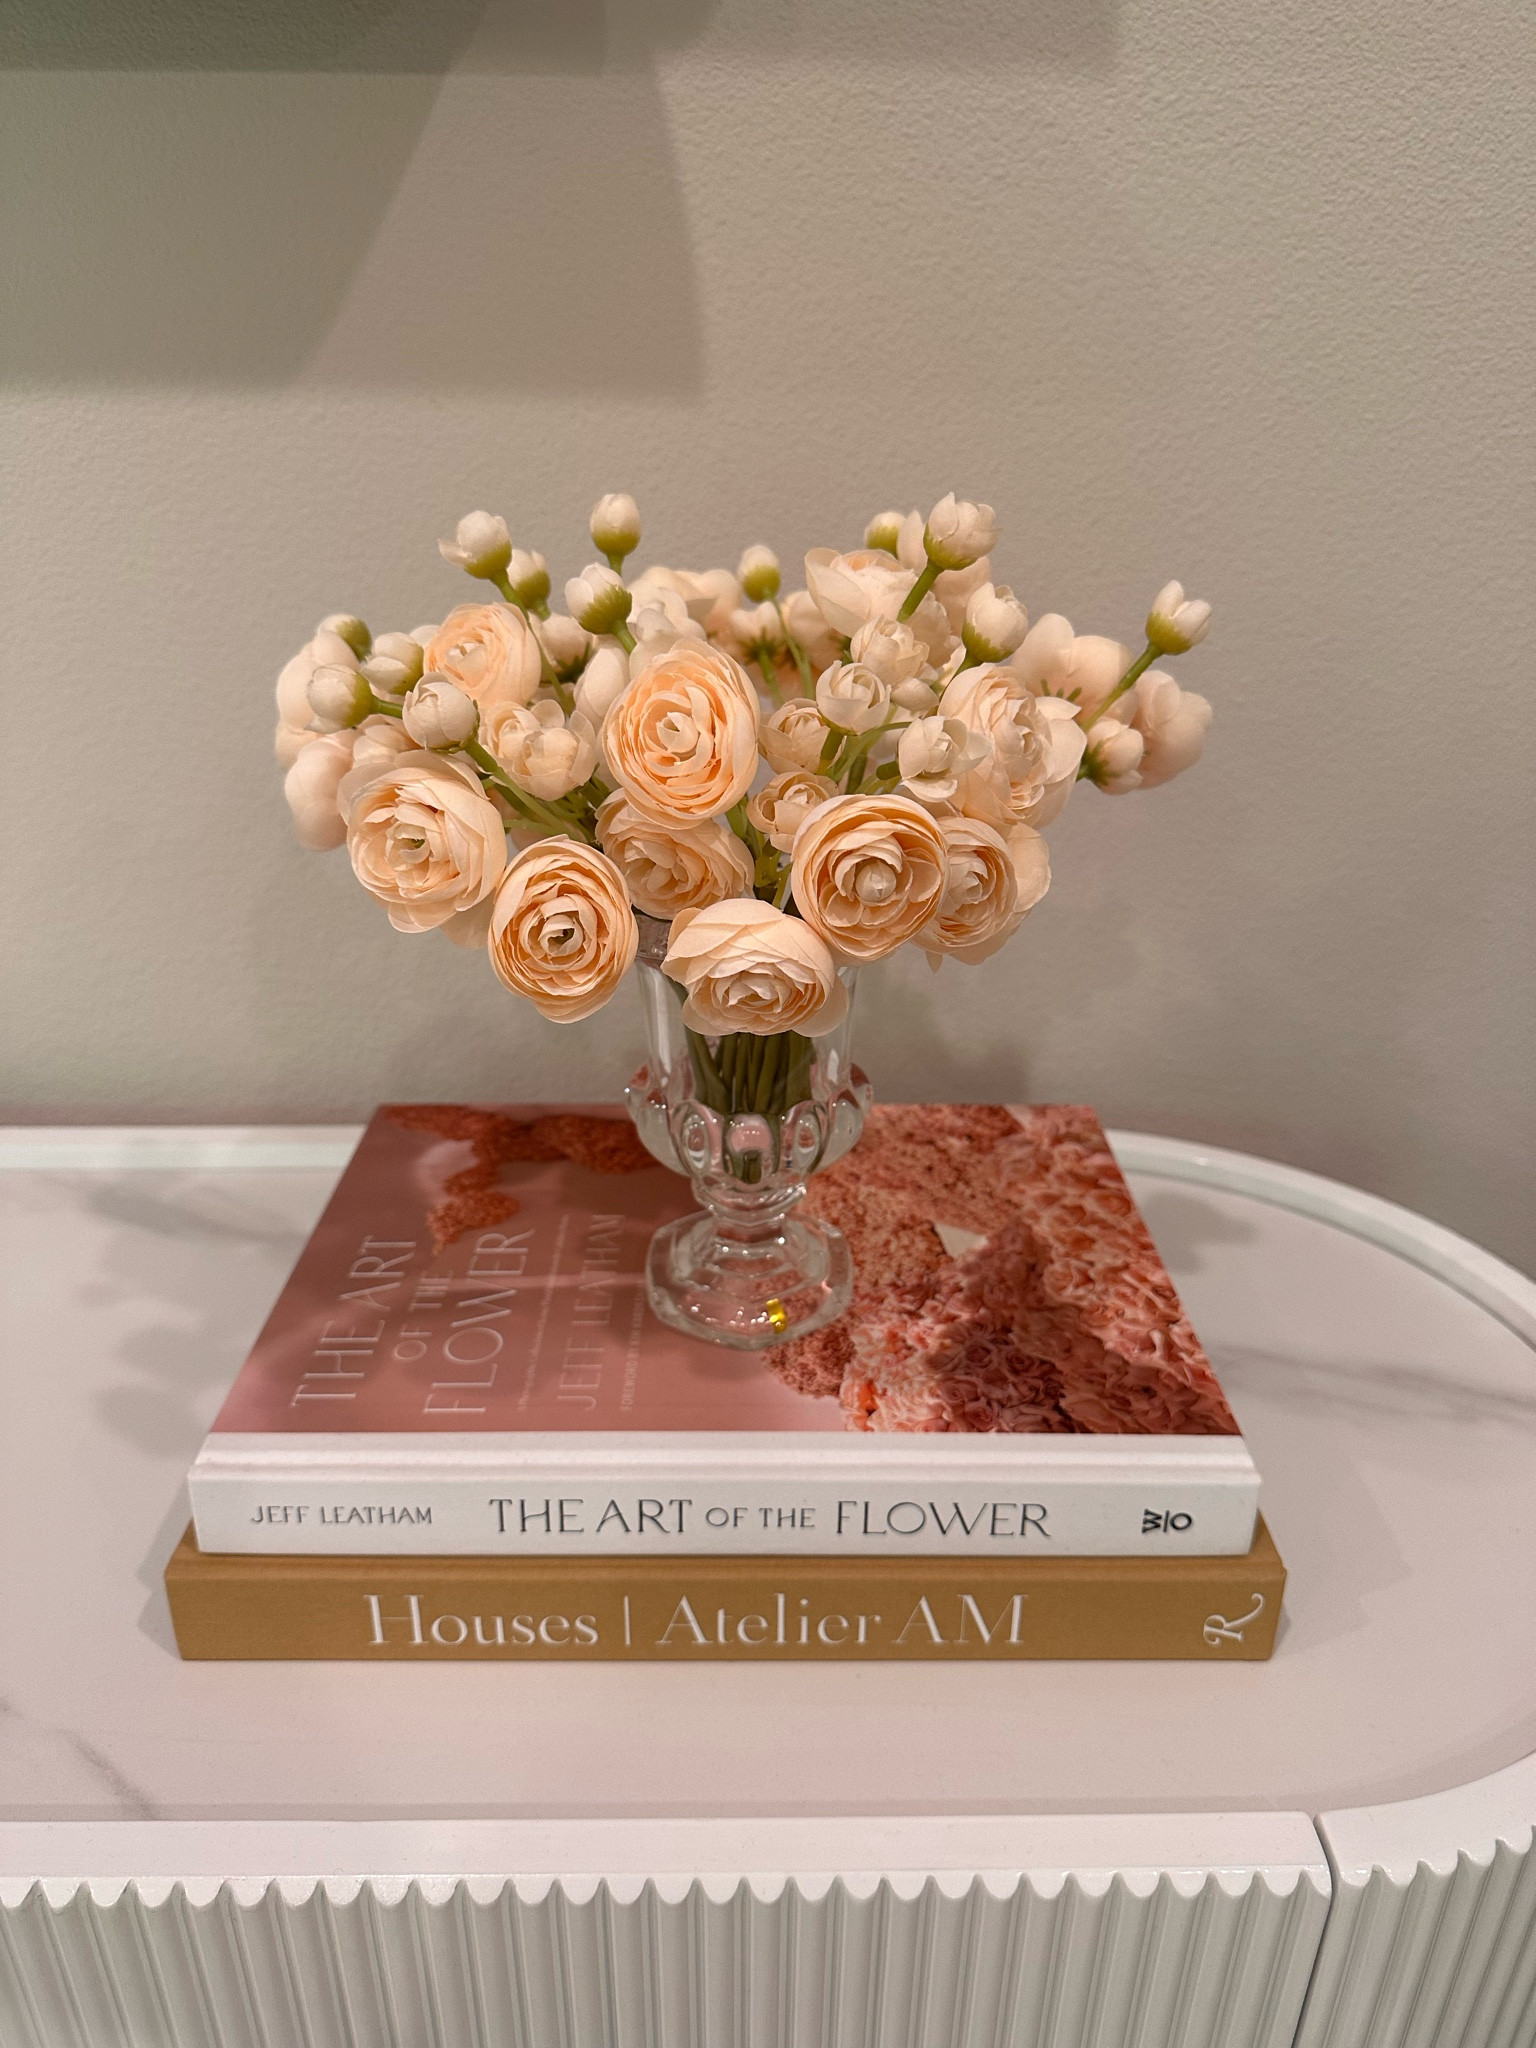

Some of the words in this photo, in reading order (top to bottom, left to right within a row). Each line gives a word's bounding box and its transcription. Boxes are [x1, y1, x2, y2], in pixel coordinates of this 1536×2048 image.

[408, 1269, 454, 1311] THE
[290, 1320, 386, 1407] THE
[340, 1235, 417, 1312] ART
[392, 1324, 431, 1362] OF
[423, 1229, 536, 1415] FLOWER
[557, 1337, 605, 1410] JEFF
[250, 1505, 310, 1525] JEFF
[320, 1505, 433, 1525] LEATHAM
[489, 1499, 584, 1533] THE
[596, 1499, 693, 1534] ART
[706, 1507, 748, 1528] OF
[758, 1507, 816, 1529] THE
[835, 1500, 1052, 1538] FLOWER
[364, 1594, 599, 1647] Houses
[656, 1593, 883, 1646] Atelier
[896, 1593, 1029, 1644] AM
